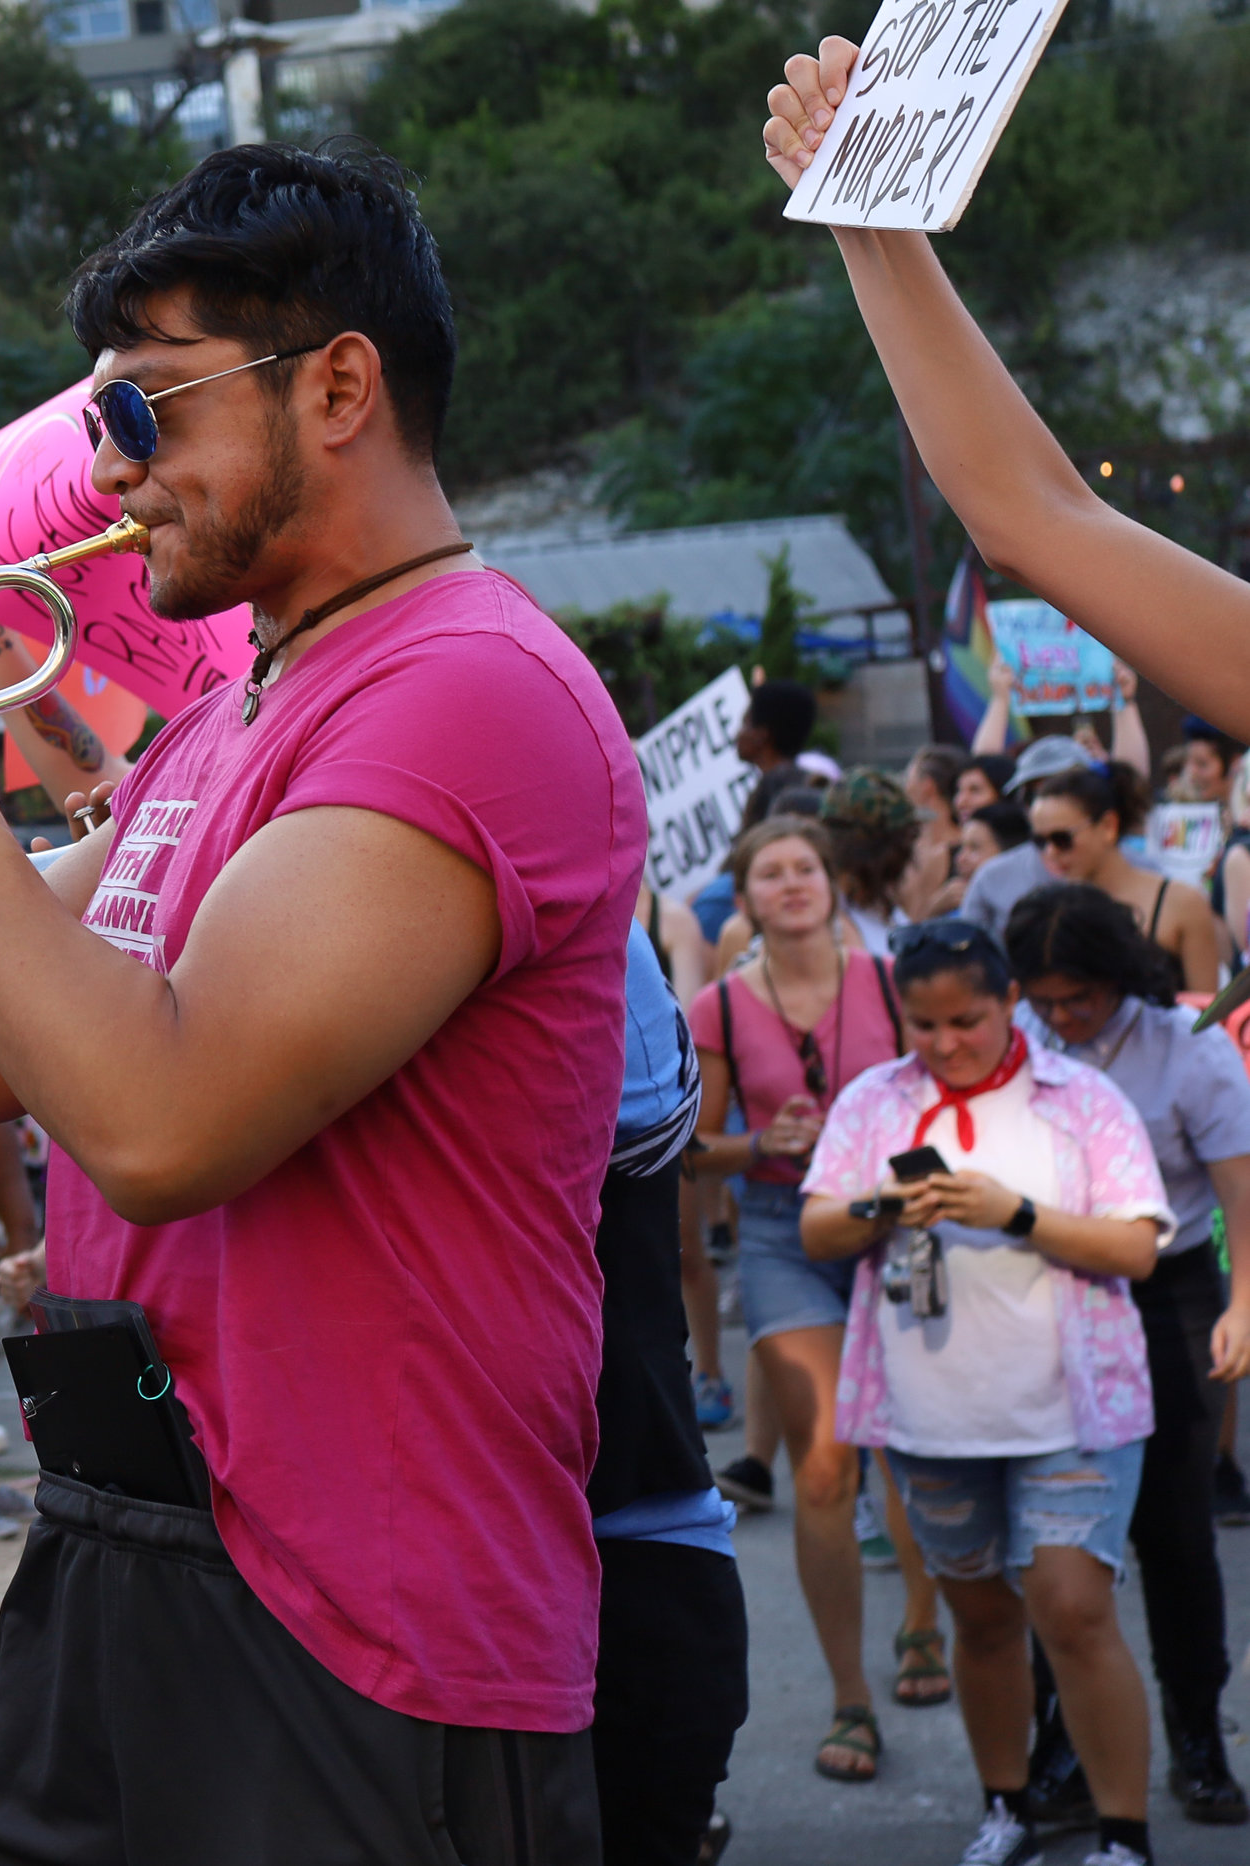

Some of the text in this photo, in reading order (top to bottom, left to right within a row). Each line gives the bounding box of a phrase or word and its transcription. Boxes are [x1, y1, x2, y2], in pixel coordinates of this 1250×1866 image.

[855, 0, 1018, 98] STOP THE
[637, 697, 741, 802] NIPPLE
